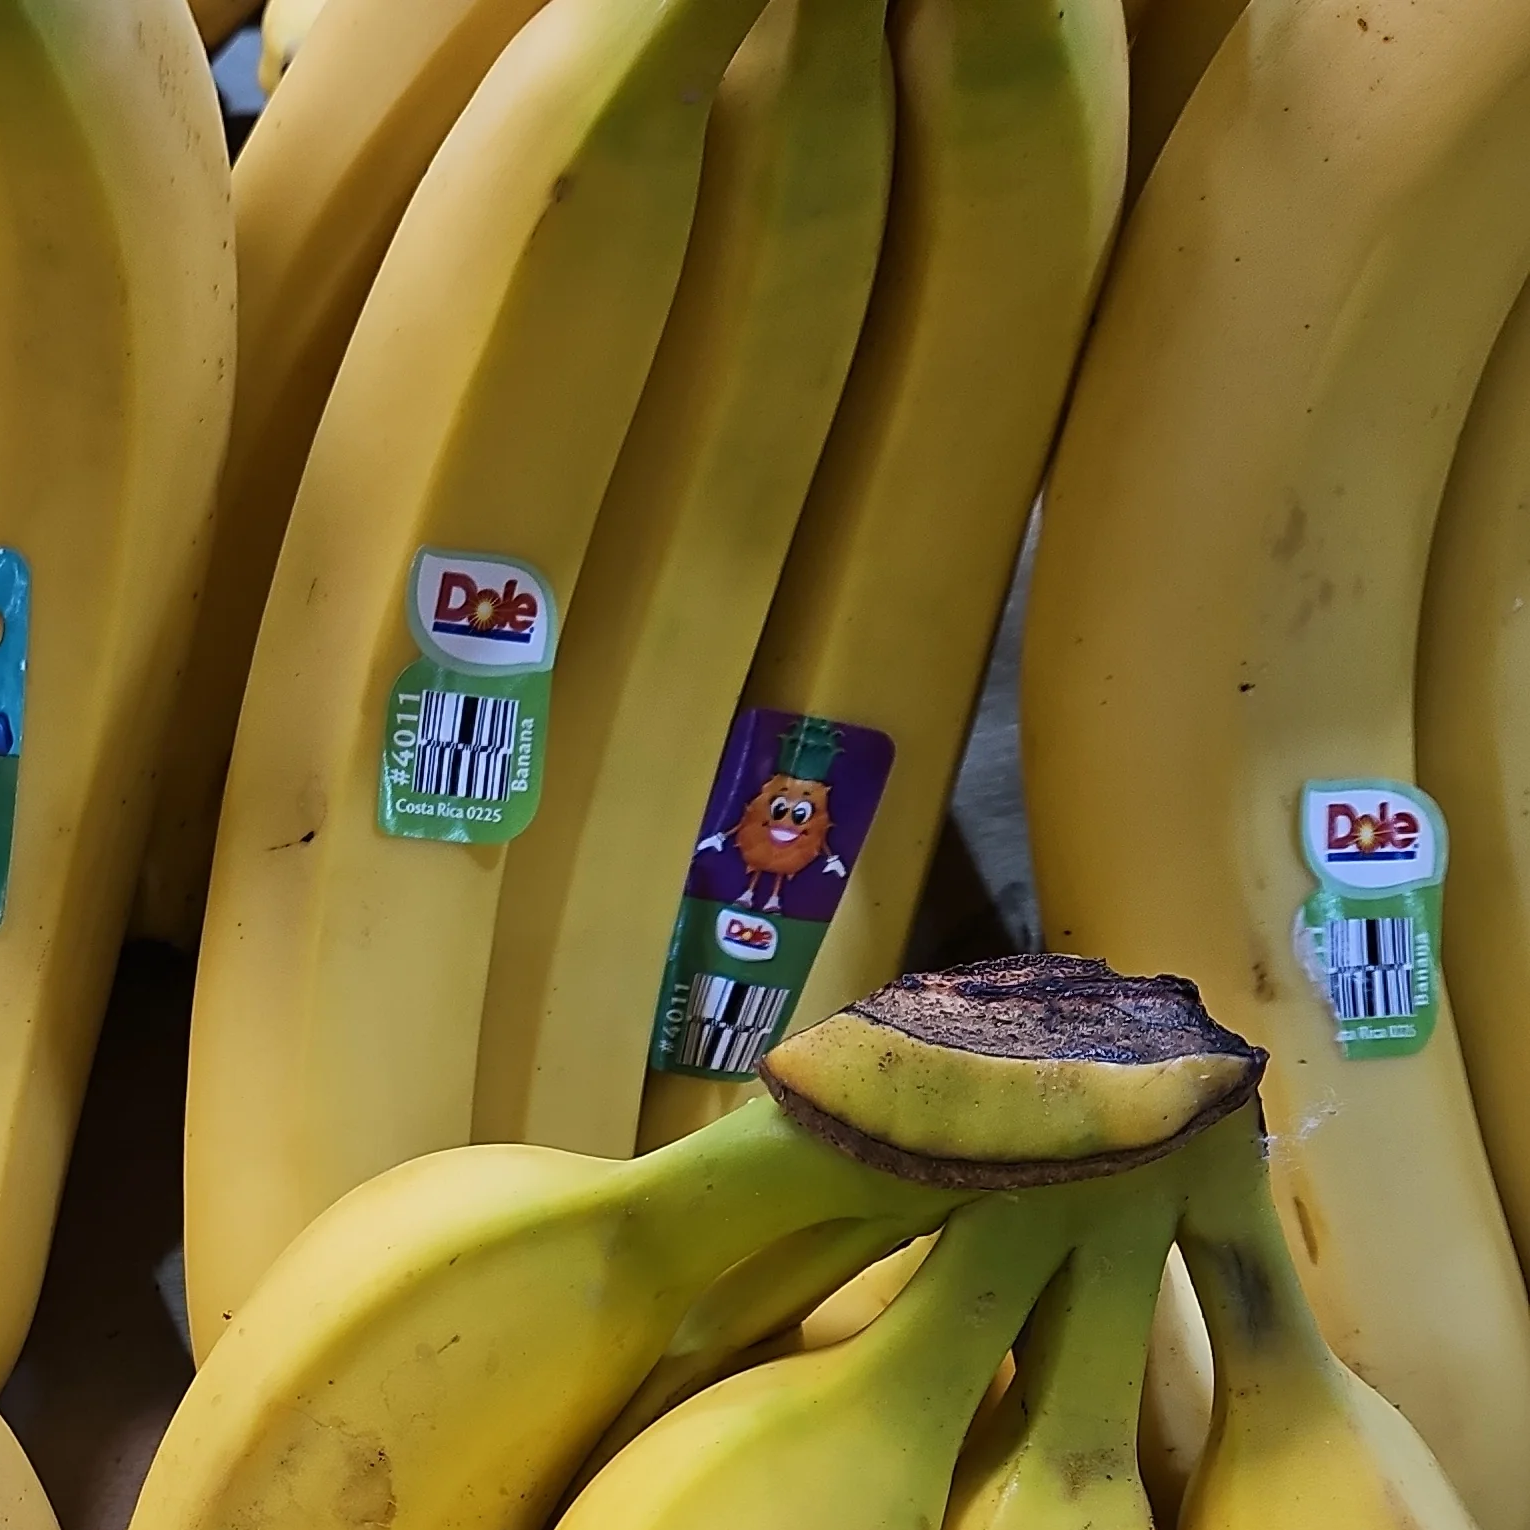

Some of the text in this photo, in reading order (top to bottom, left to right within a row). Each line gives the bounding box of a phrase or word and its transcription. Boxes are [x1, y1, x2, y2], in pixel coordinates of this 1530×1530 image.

[435, 571, 538, 632] Dole
[389, 692, 421, 786] #4011
[511, 717, 535, 792] Banana
[395, 798, 502, 823] Costa Rica 0225
[1327, 802, 1419, 852] Dole
[726, 919, 772, 946] Dole
[658, 984, 690, 1053] #4011
